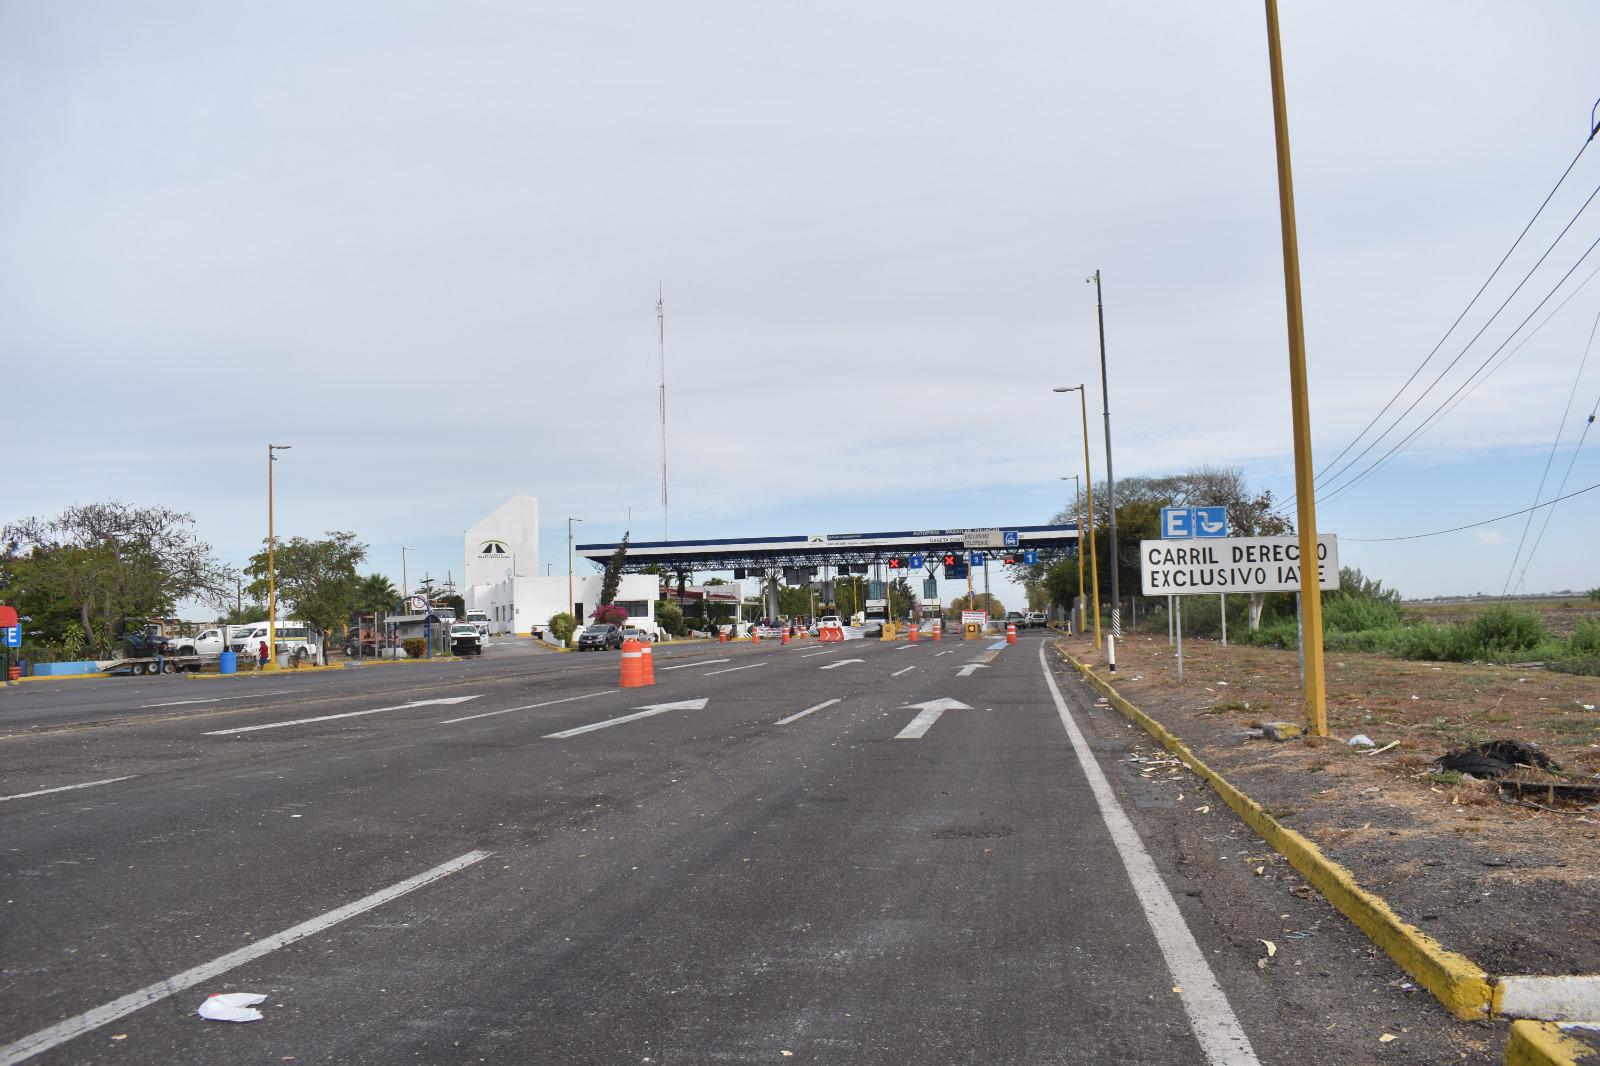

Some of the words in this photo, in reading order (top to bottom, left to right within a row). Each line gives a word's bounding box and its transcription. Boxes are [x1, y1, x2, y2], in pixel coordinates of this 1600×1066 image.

[1167, 511, 1188, 536] E
[1026, 554, 1033, 563] 1
[1148, 547, 1219, 566] CARRIL
[1232, 543, 1327, 563] DERECO
[1151, 567, 1266, 588] EXCLUSIVO
[1278, 565, 1326, 584] IAE
[8, 627, 17, 643] E
